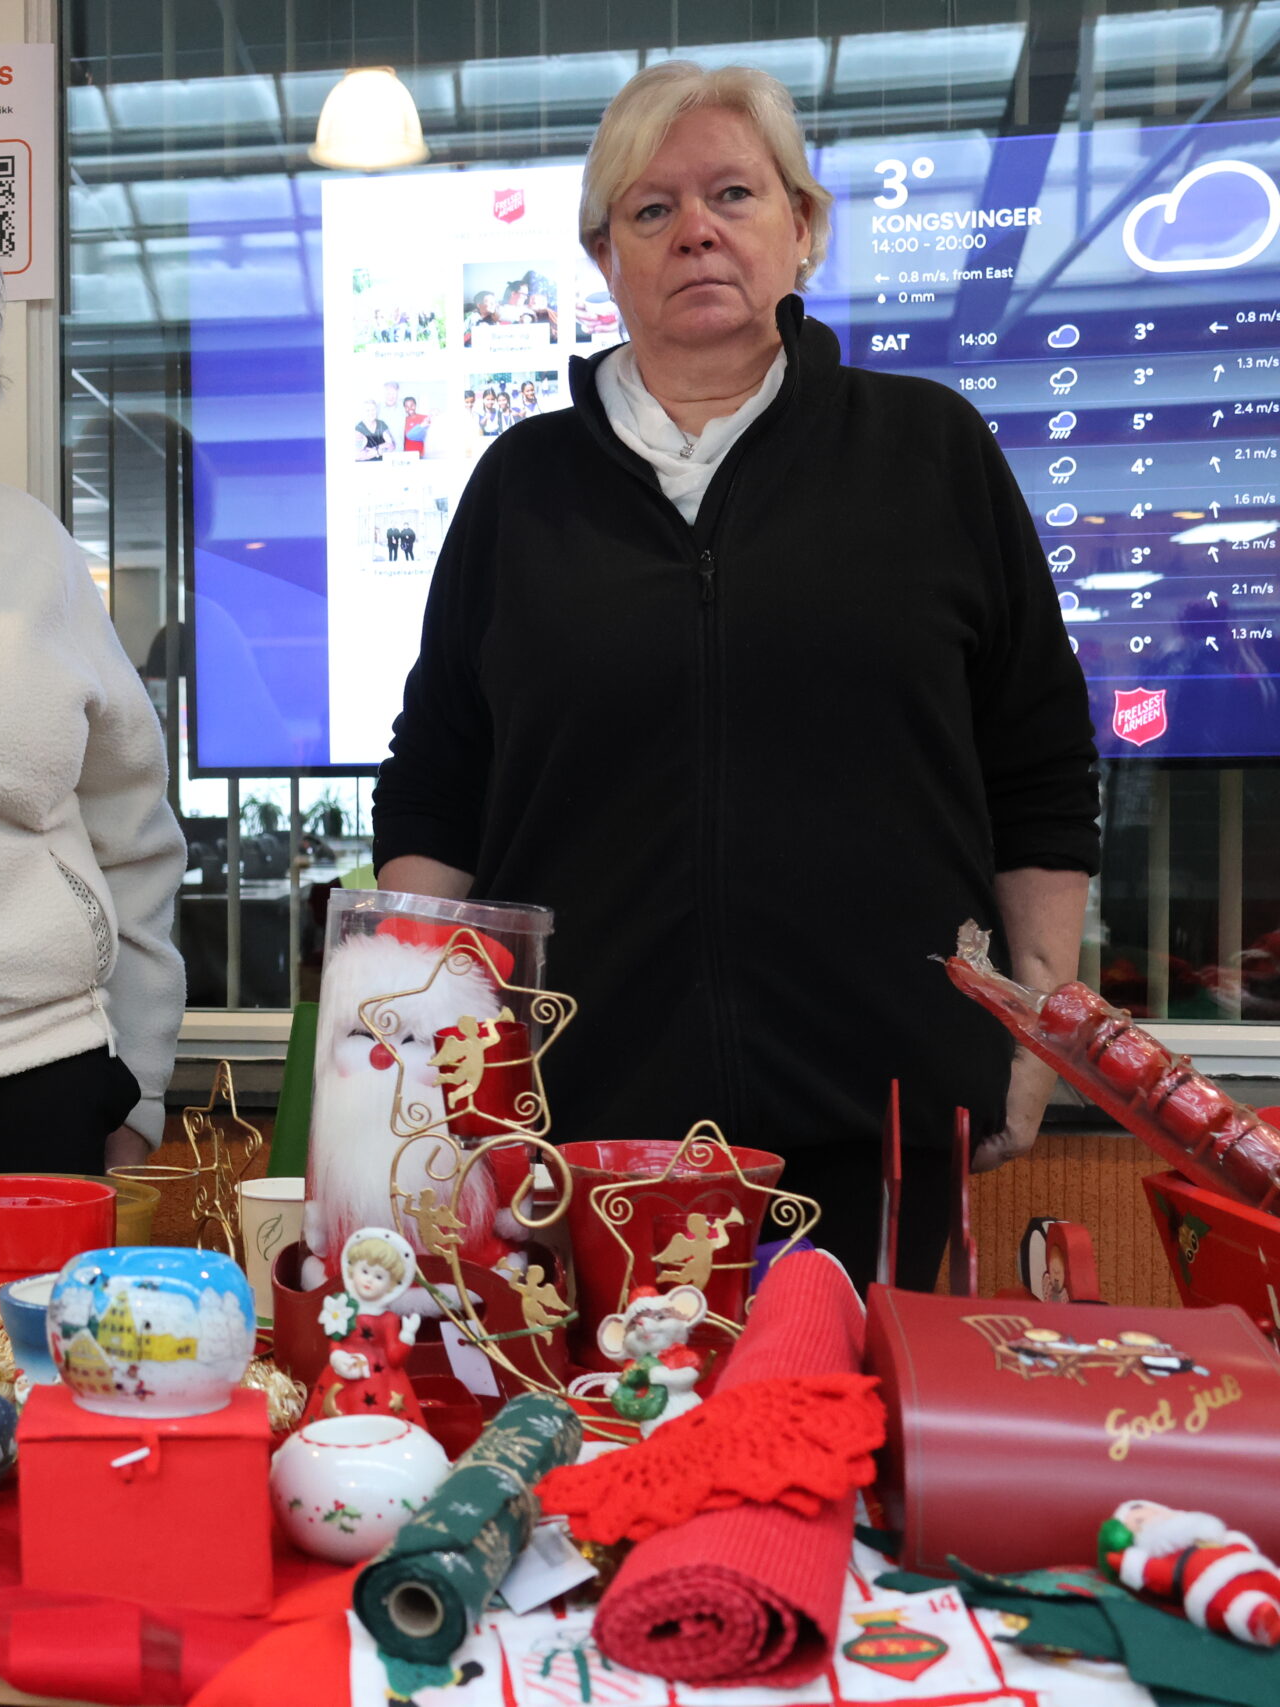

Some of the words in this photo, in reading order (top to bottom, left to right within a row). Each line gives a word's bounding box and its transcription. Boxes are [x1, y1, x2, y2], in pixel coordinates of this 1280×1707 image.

[872, 207, 1042, 234] KONGSVINGER
[872, 237, 919, 254] 14:00
[935, 234, 987, 251] 20:00
[898, 271, 919, 283] 0.8
[922, 270, 949, 283] m/s,
[953, 269, 982, 281] from
[986, 266, 1014, 279] East
[898, 292, 907, 303] 0
[911, 292, 935, 303] mm
[871, 333, 910, 352] SAT
[959, 332, 998, 347] 14:00
[1236, 311, 1256, 323] 0.8
[1259, 309, 1280, 323] m/s
[959, 377, 997, 391] 18:00
[1237, 357, 1253, 369] 1.3
[1255, 355, 1280, 369] m/s
[1234, 403, 1253, 414] 2.4
[1256, 401, 1280, 414] m/s
[1234, 448, 1251, 460] 2.1
[1253, 447, 1277, 459] m/s
[1234, 493, 1250, 504] 1.6
[1252, 492, 1276, 505] m/s
[1232, 539, 1250, 550] 2.5
[1252, 538, 1276, 550] m/s
[1231, 583, 1248, 595] 2.1
[1250, 582, 1274, 595] m/s
[1231, 628, 1247, 639] 1.3
[1249, 627, 1273, 640] m/s
[1117, 694, 1161, 726] FRELSES
[1122, 707, 1161, 735] ARMEEN
[1105, 1399, 1177, 1462] God
[1184, 1374, 1242, 1433] jul
